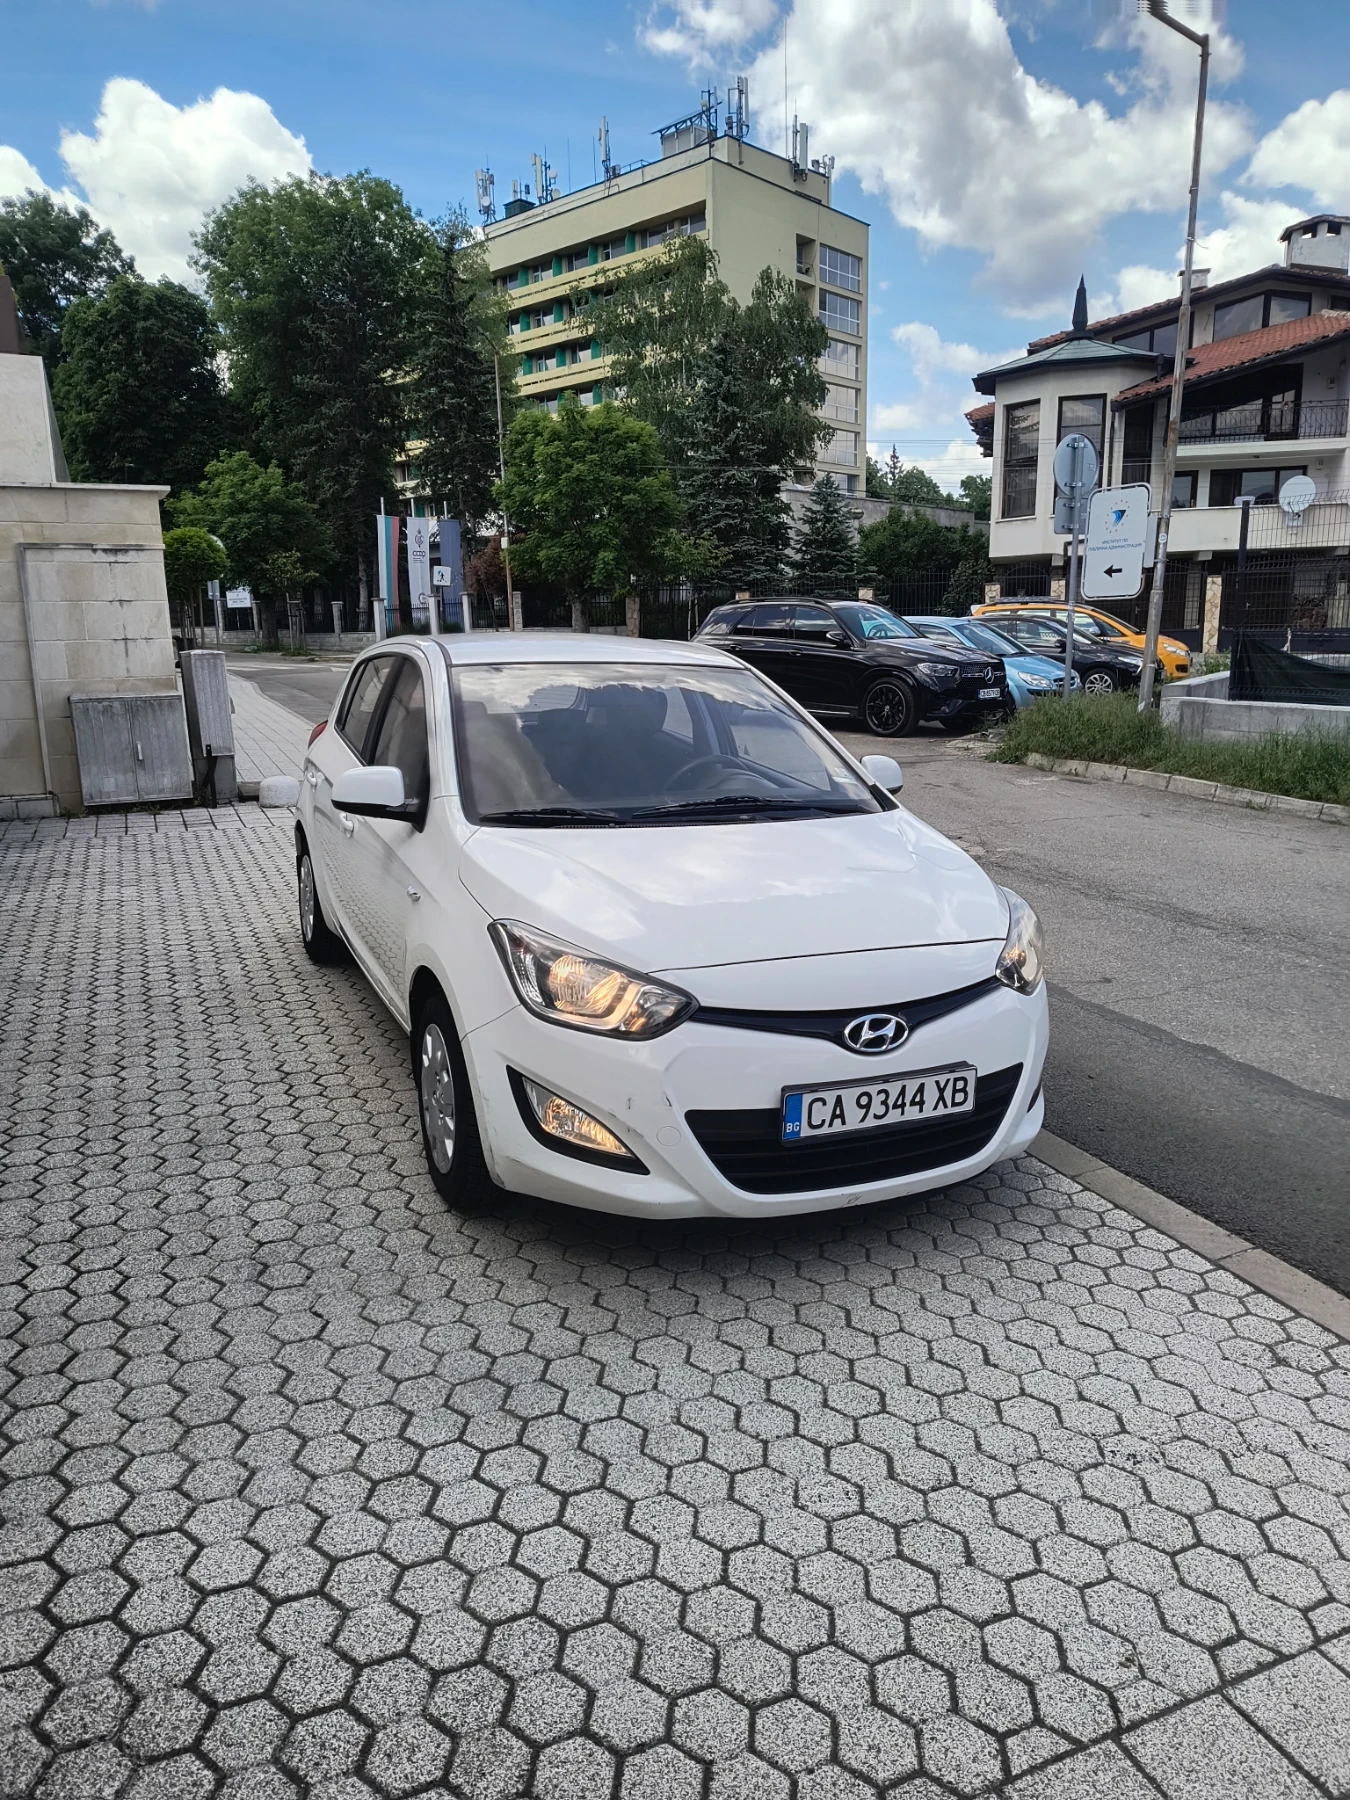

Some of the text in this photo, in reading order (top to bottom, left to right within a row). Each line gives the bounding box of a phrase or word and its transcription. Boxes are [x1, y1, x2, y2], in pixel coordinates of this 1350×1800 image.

[807, 1076, 969, 1130] CA 9344 XB
[786, 1122, 800, 1133] BG
